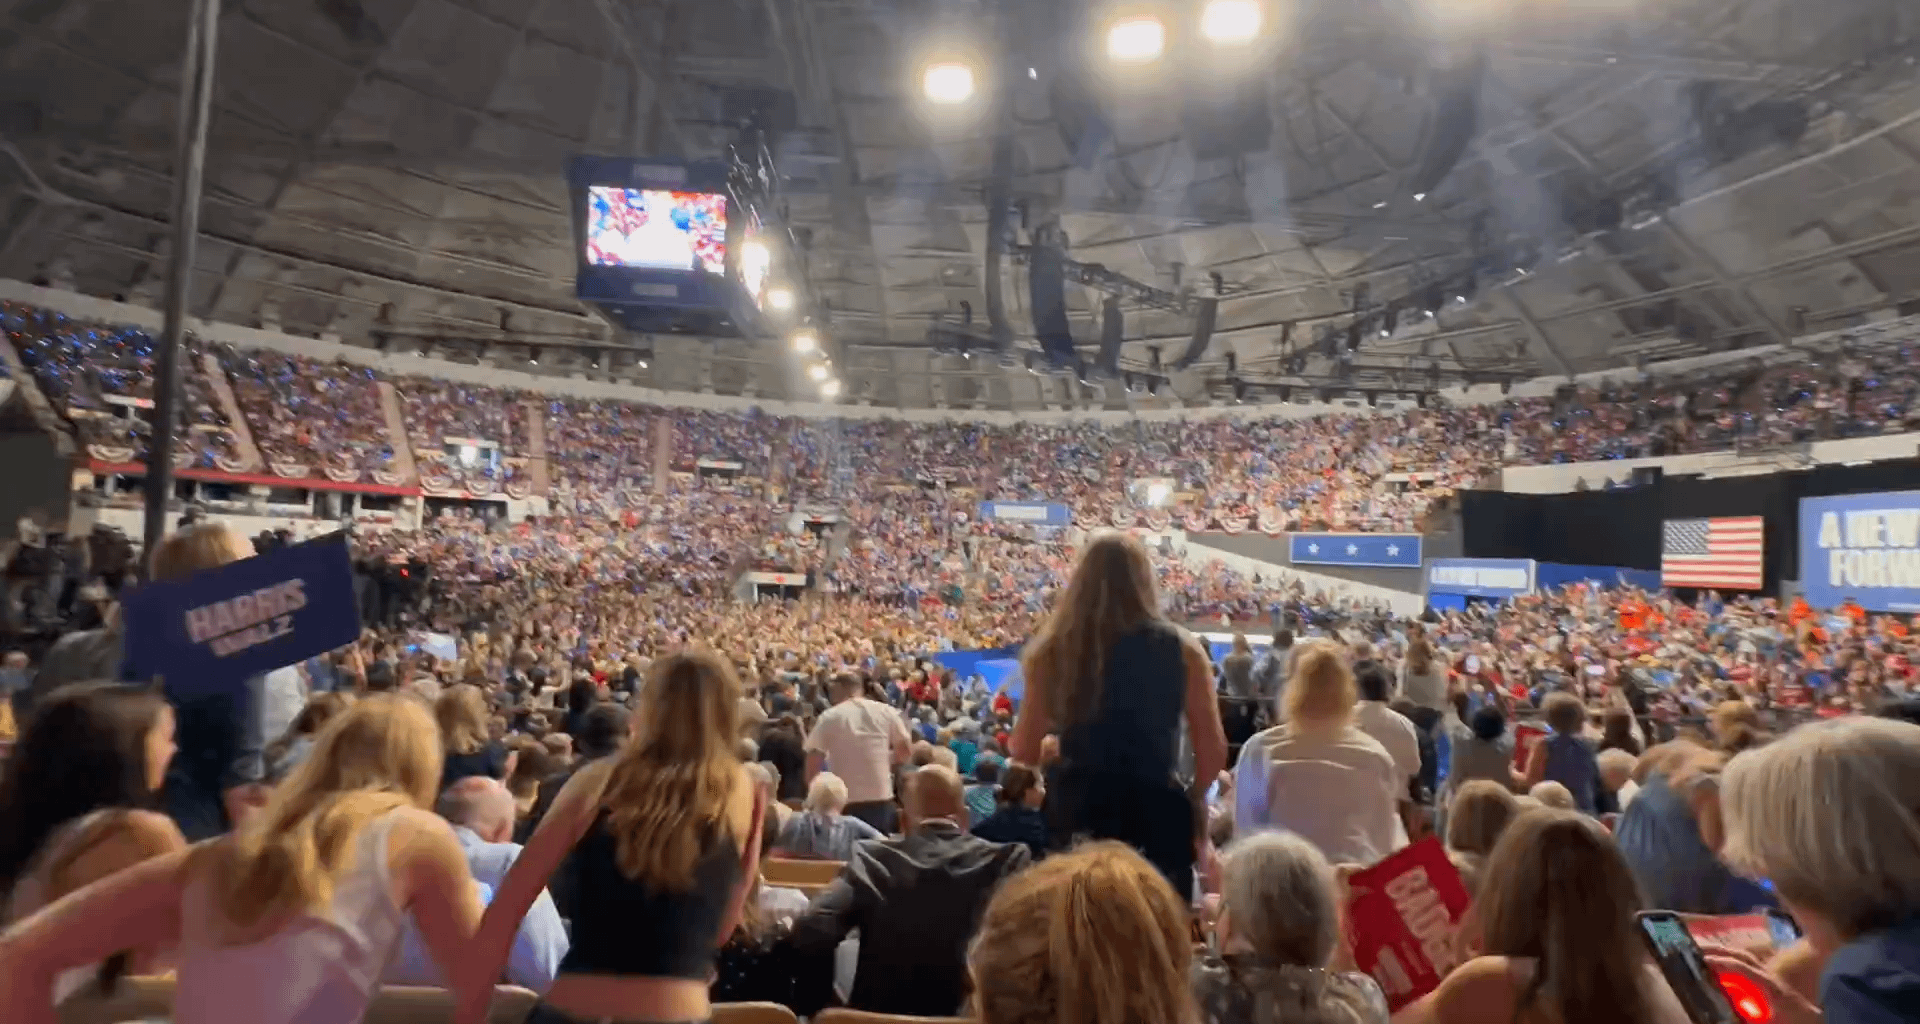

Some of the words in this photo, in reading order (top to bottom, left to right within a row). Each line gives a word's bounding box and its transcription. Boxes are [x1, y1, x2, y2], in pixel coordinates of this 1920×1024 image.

[1818, 511, 1842, 548] A
[1845, 508, 1919, 548] NEW
[185, 578, 308, 644] HARRIS
[209, 614, 295, 657] WALZ
